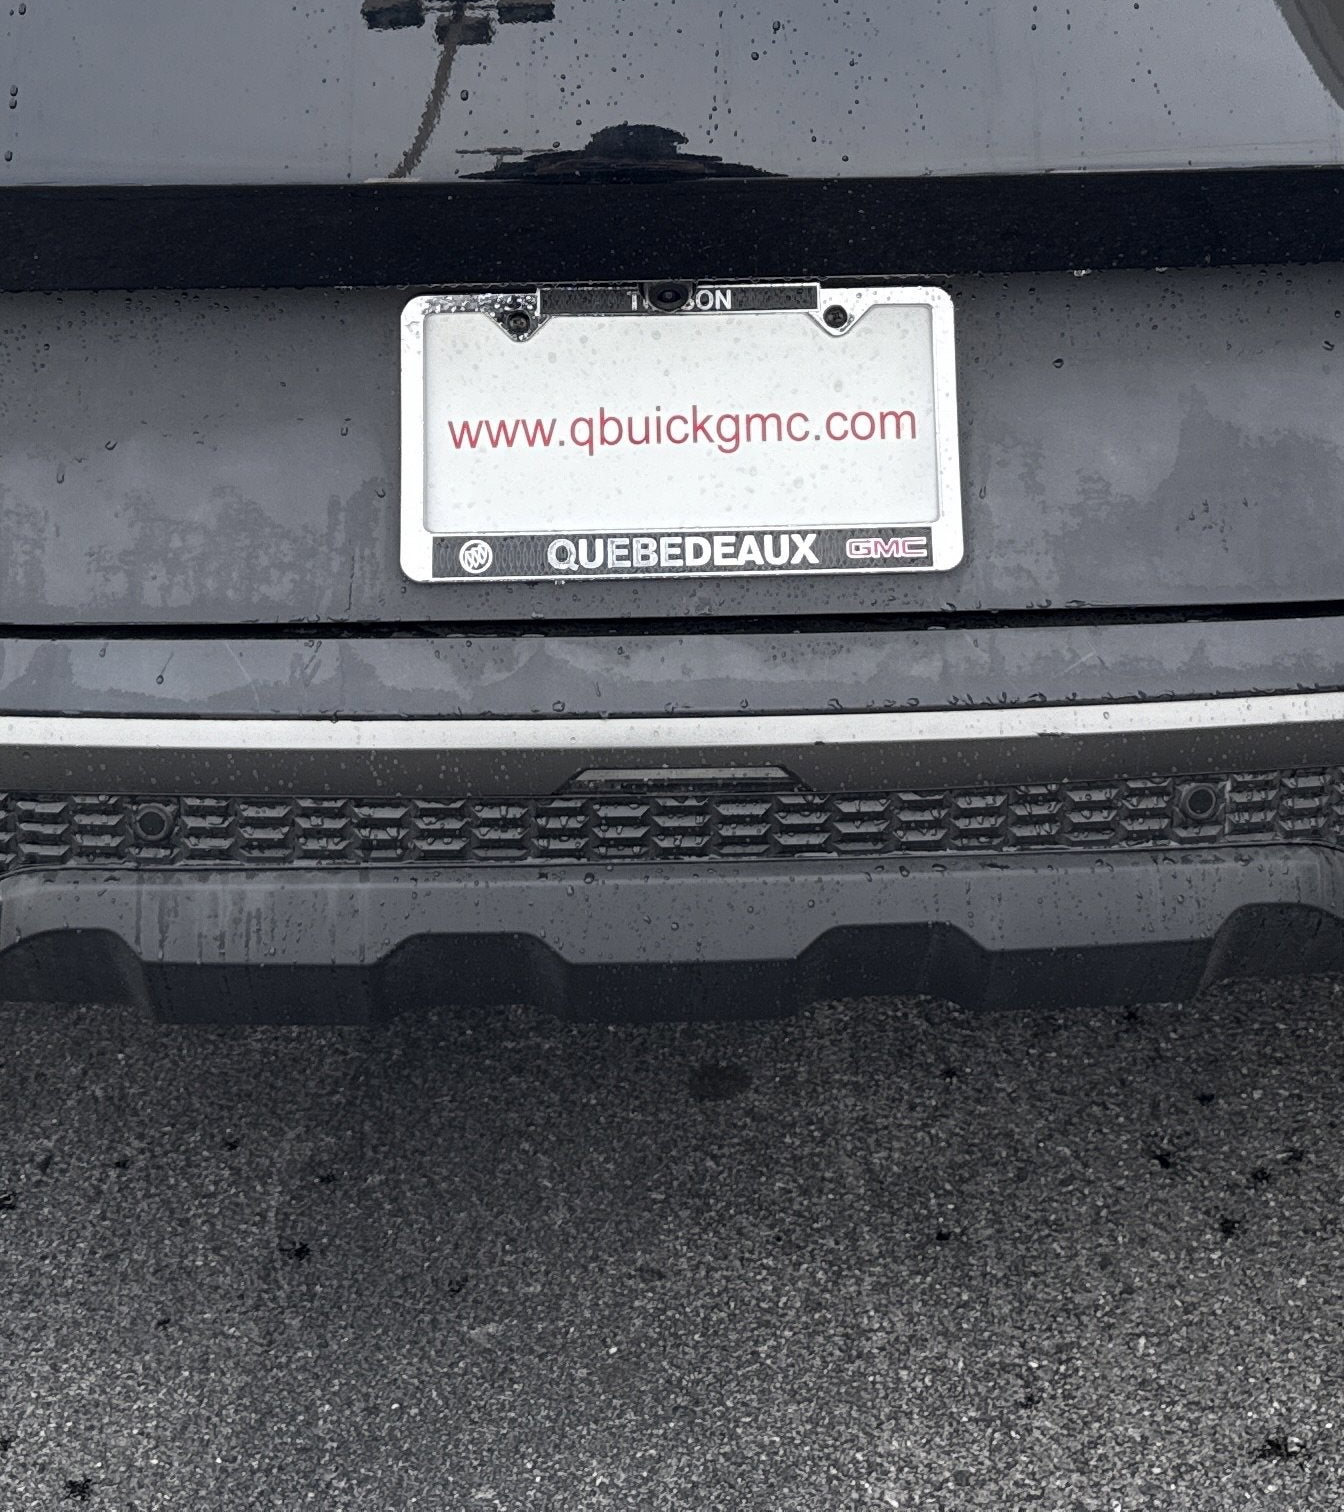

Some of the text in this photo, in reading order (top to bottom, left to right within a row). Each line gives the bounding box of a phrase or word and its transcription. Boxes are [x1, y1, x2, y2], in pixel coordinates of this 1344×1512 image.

[447, 404, 917, 456] www.qbuickgmc.com
[547, 533, 820, 571] QUEBEDEAUX
[845, 536, 928, 558] GMC
